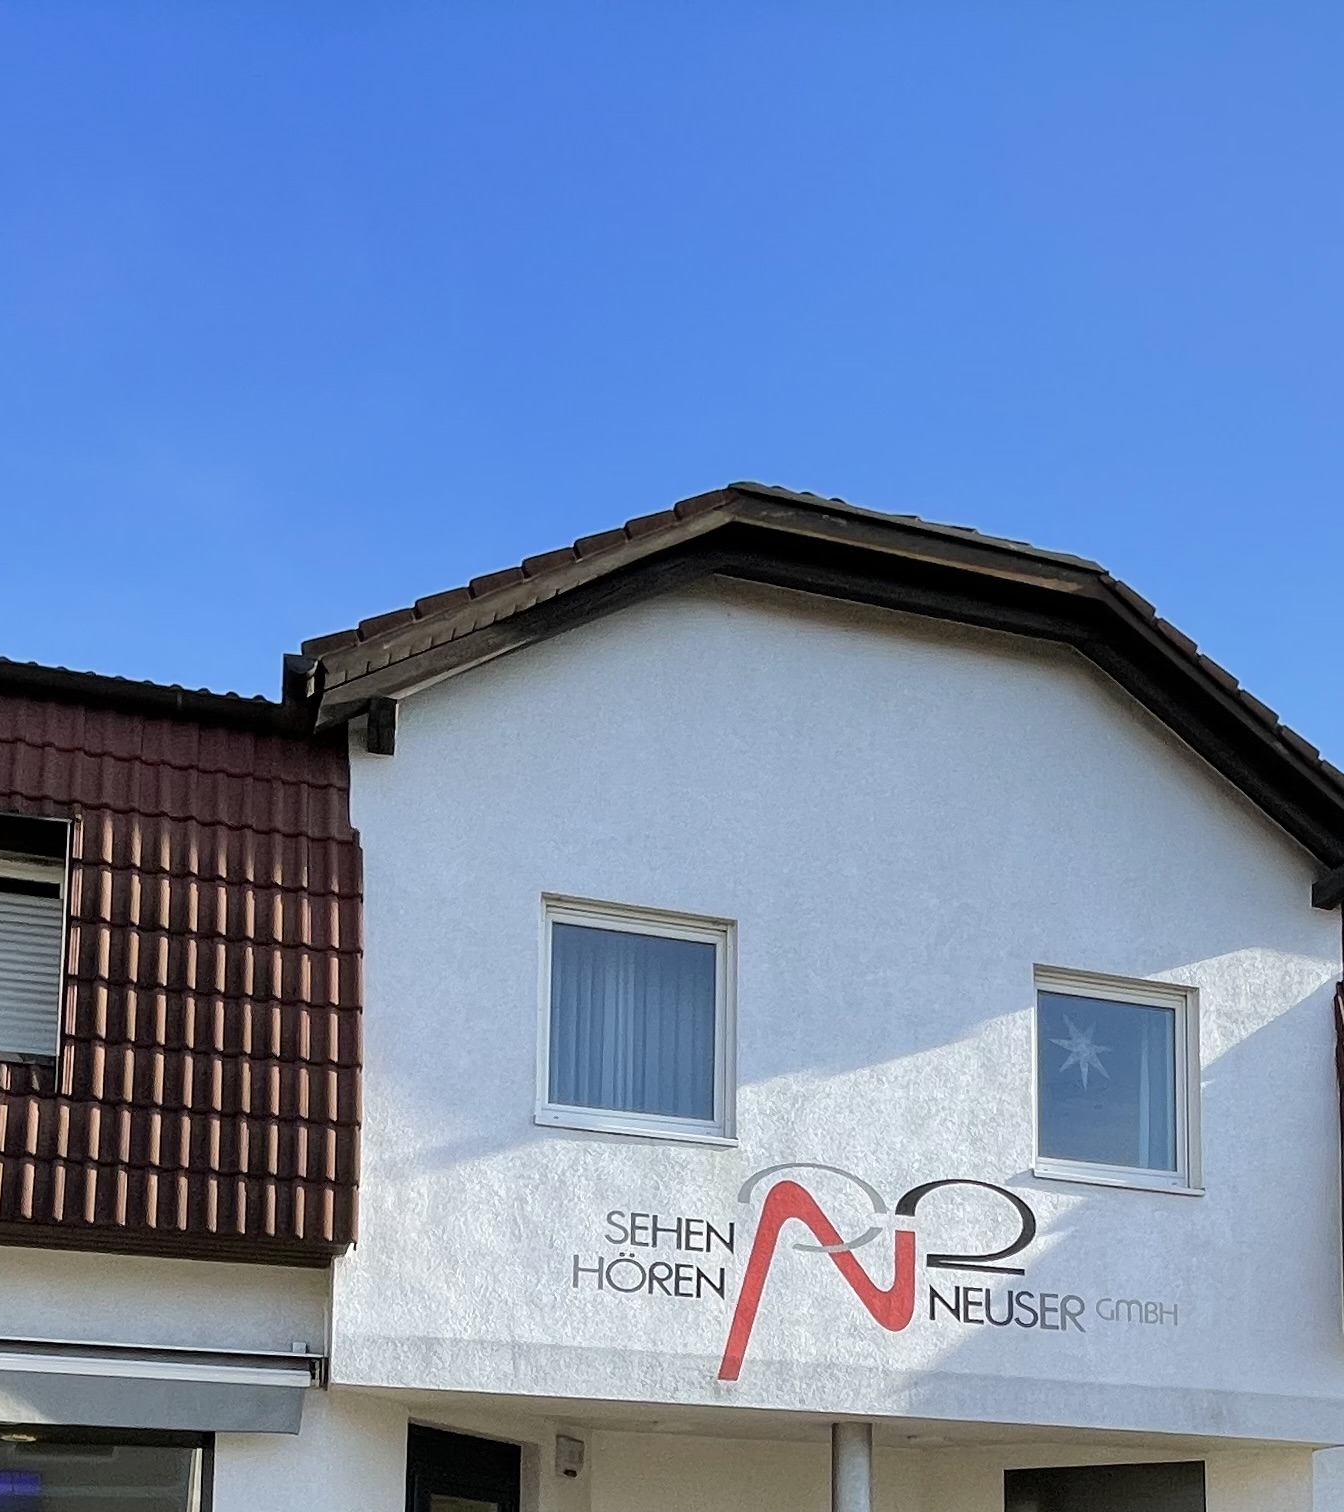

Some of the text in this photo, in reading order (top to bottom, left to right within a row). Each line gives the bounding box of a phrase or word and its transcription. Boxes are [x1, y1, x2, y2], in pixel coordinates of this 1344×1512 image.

[603, 1210, 735, 1255] SEHEN
[571, 1251, 726, 1301] HÖREN
[928, 1284, 1086, 1334] NEUSER
